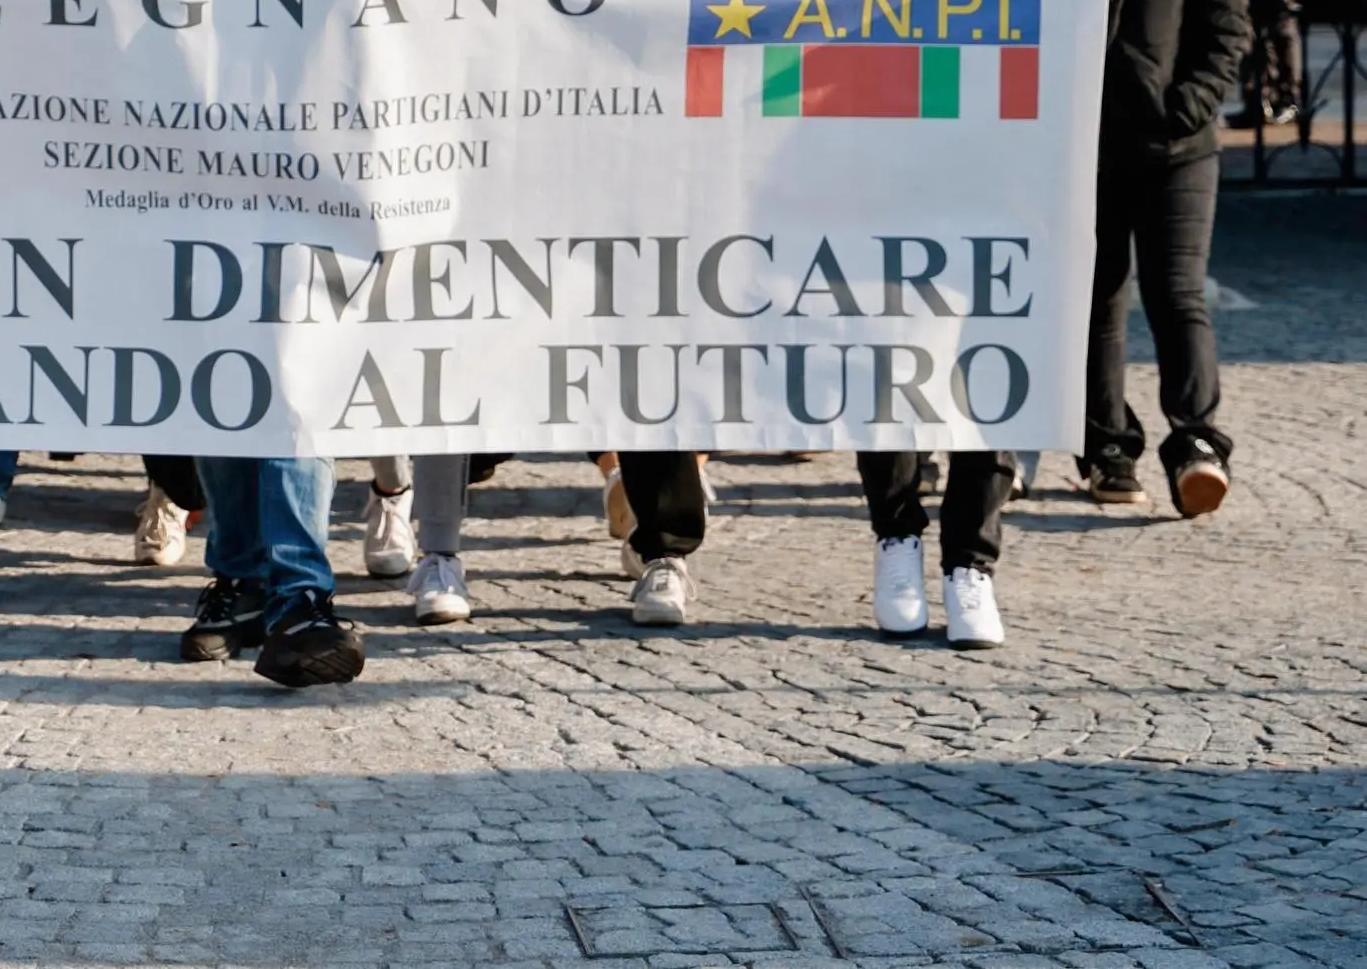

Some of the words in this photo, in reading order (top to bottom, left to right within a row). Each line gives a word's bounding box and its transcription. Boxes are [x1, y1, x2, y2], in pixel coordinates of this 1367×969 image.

[124, 100, 318, 131] NAZIONALE
[331, 91, 509, 130] PARTIGIANI
[522, 87, 664, 117] D'ITALIA
[44, 140, 184, 174] SEZIONE
[197, 149, 320, 181] MAURO
[332, 139, 489, 180] VENEGONI
[85, 188, 170, 213] Medaglia
[179, 192, 233, 210] d'Oro
[242, 193, 258, 211] al
[267, 195, 310, 213] V.M.
[318, 200, 361, 219] della
[369, 195, 451, 220] Resistenza
[164, 233, 1033, 324] DIMENTICARE
[333, 346, 481, 430] AL
[540, 342, 1031, 426] FUTURO
